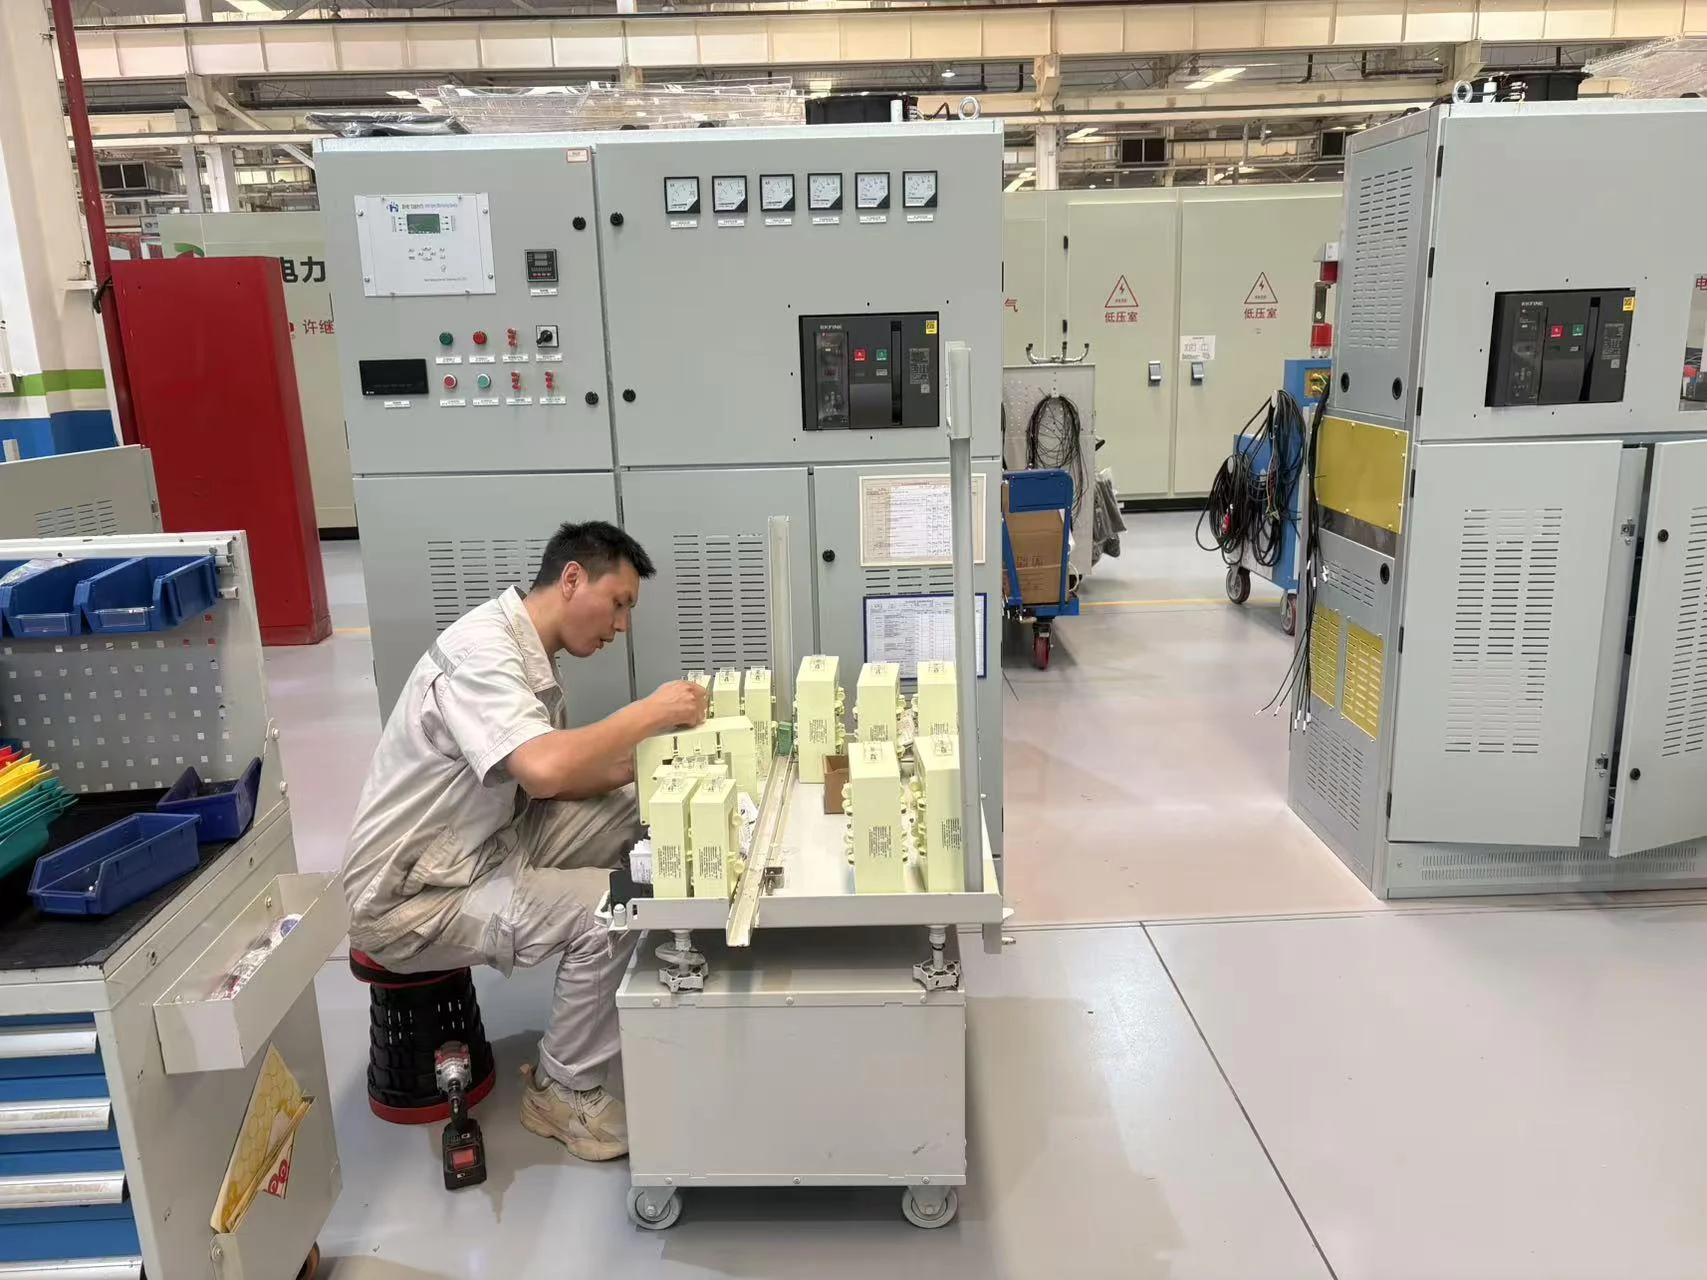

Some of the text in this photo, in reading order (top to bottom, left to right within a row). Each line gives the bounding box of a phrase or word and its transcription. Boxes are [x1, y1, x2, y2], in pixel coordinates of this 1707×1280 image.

[280, 256, 326, 283] 电力
[1104, 311, 1138, 323] 低压室
[1244, 308, 1277, 320] 低压室
[302, 319, 335, 335] 许继
